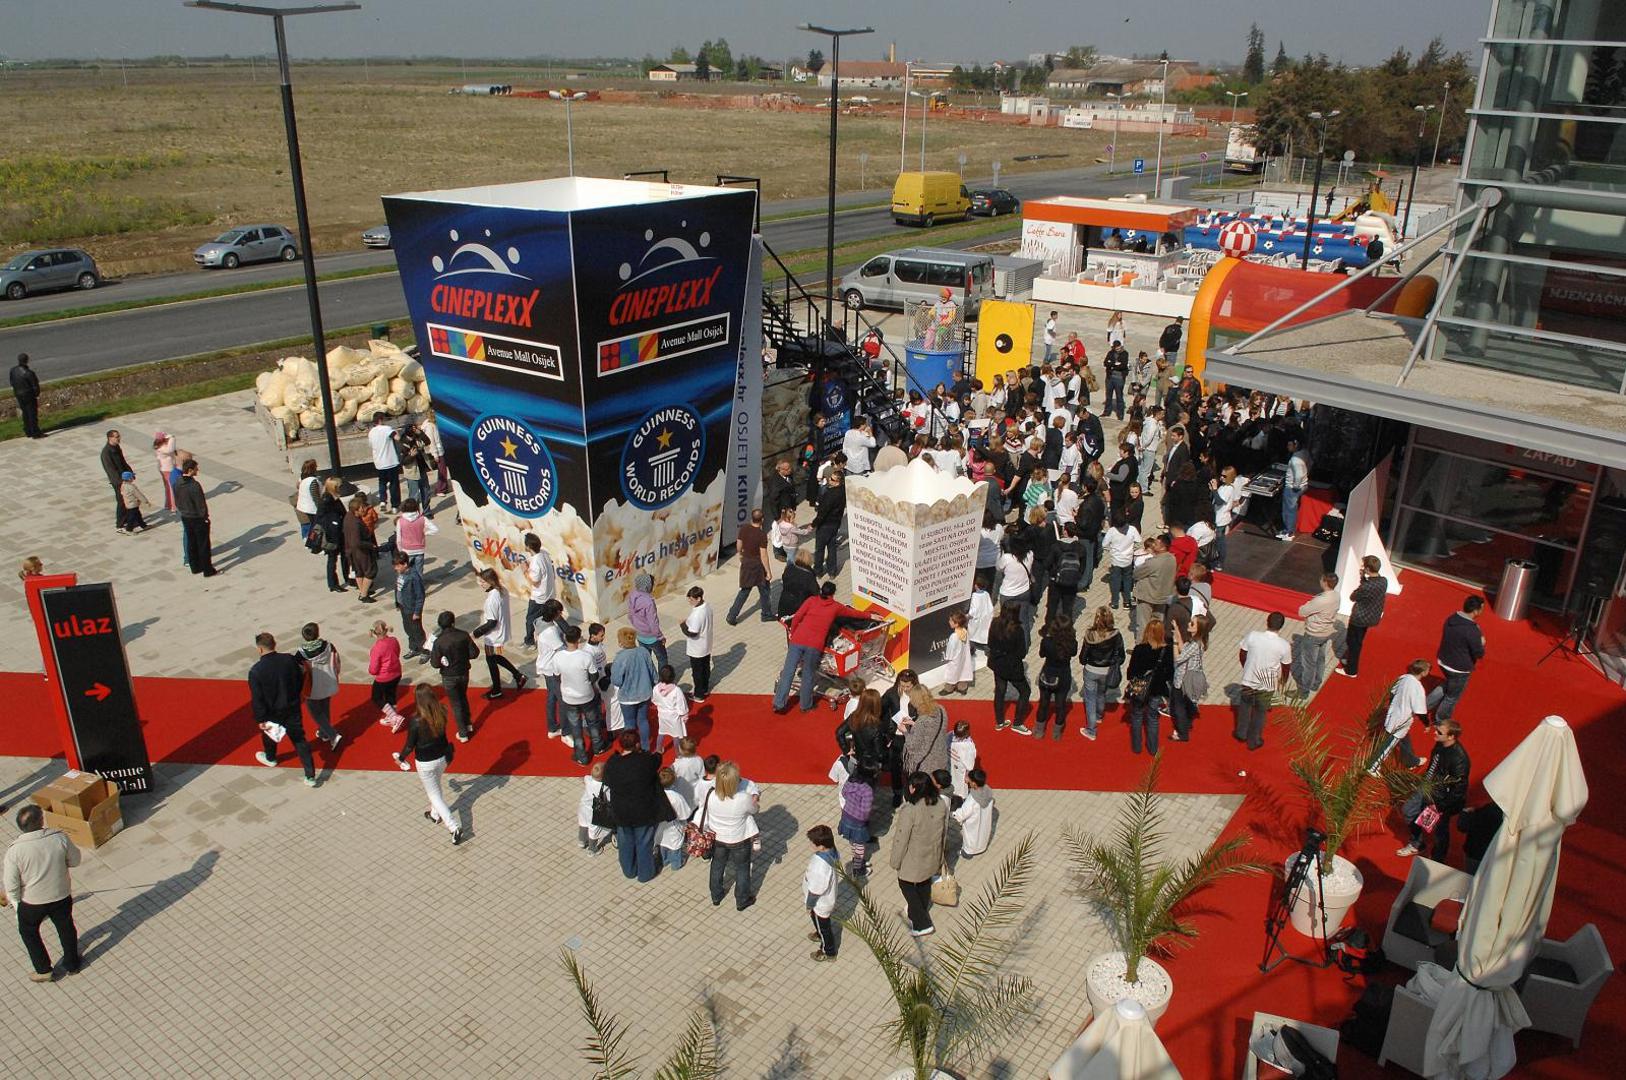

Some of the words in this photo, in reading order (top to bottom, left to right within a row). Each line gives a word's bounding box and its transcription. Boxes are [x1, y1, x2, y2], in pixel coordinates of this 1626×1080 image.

[431, 283, 540, 328] CINEPLEXX
[608, 265, 723, 326] CINEPLEXX
[660, 338, 686, 350] Avenue
[687, 330, 702, 343] Mall
[704, 325, 724, 340] Osijek
[487, 344, 514, 360] Avenue
[514, 349, 530, 363] Mall
[532, 353, 556, 368] Osijek
[478, 418, 540, 454] GUINNESS
[633, 409, 696, 448] GUINNESS
[738, 412, 748, 468] OSJETI
[626, 461, 656, 502] WORLD
[660, 439, 700, 501] RECORDS
[1522, 449, 1577, 468] ZAPAD
[475, 452, 511, 504] WORLD
[514, 468, 550, 510] RECORDS
[890, 536, 907, 548] OVOM
[957, 526, 975, 536] OVOM
[54, 614, 112, 638] ulaz
